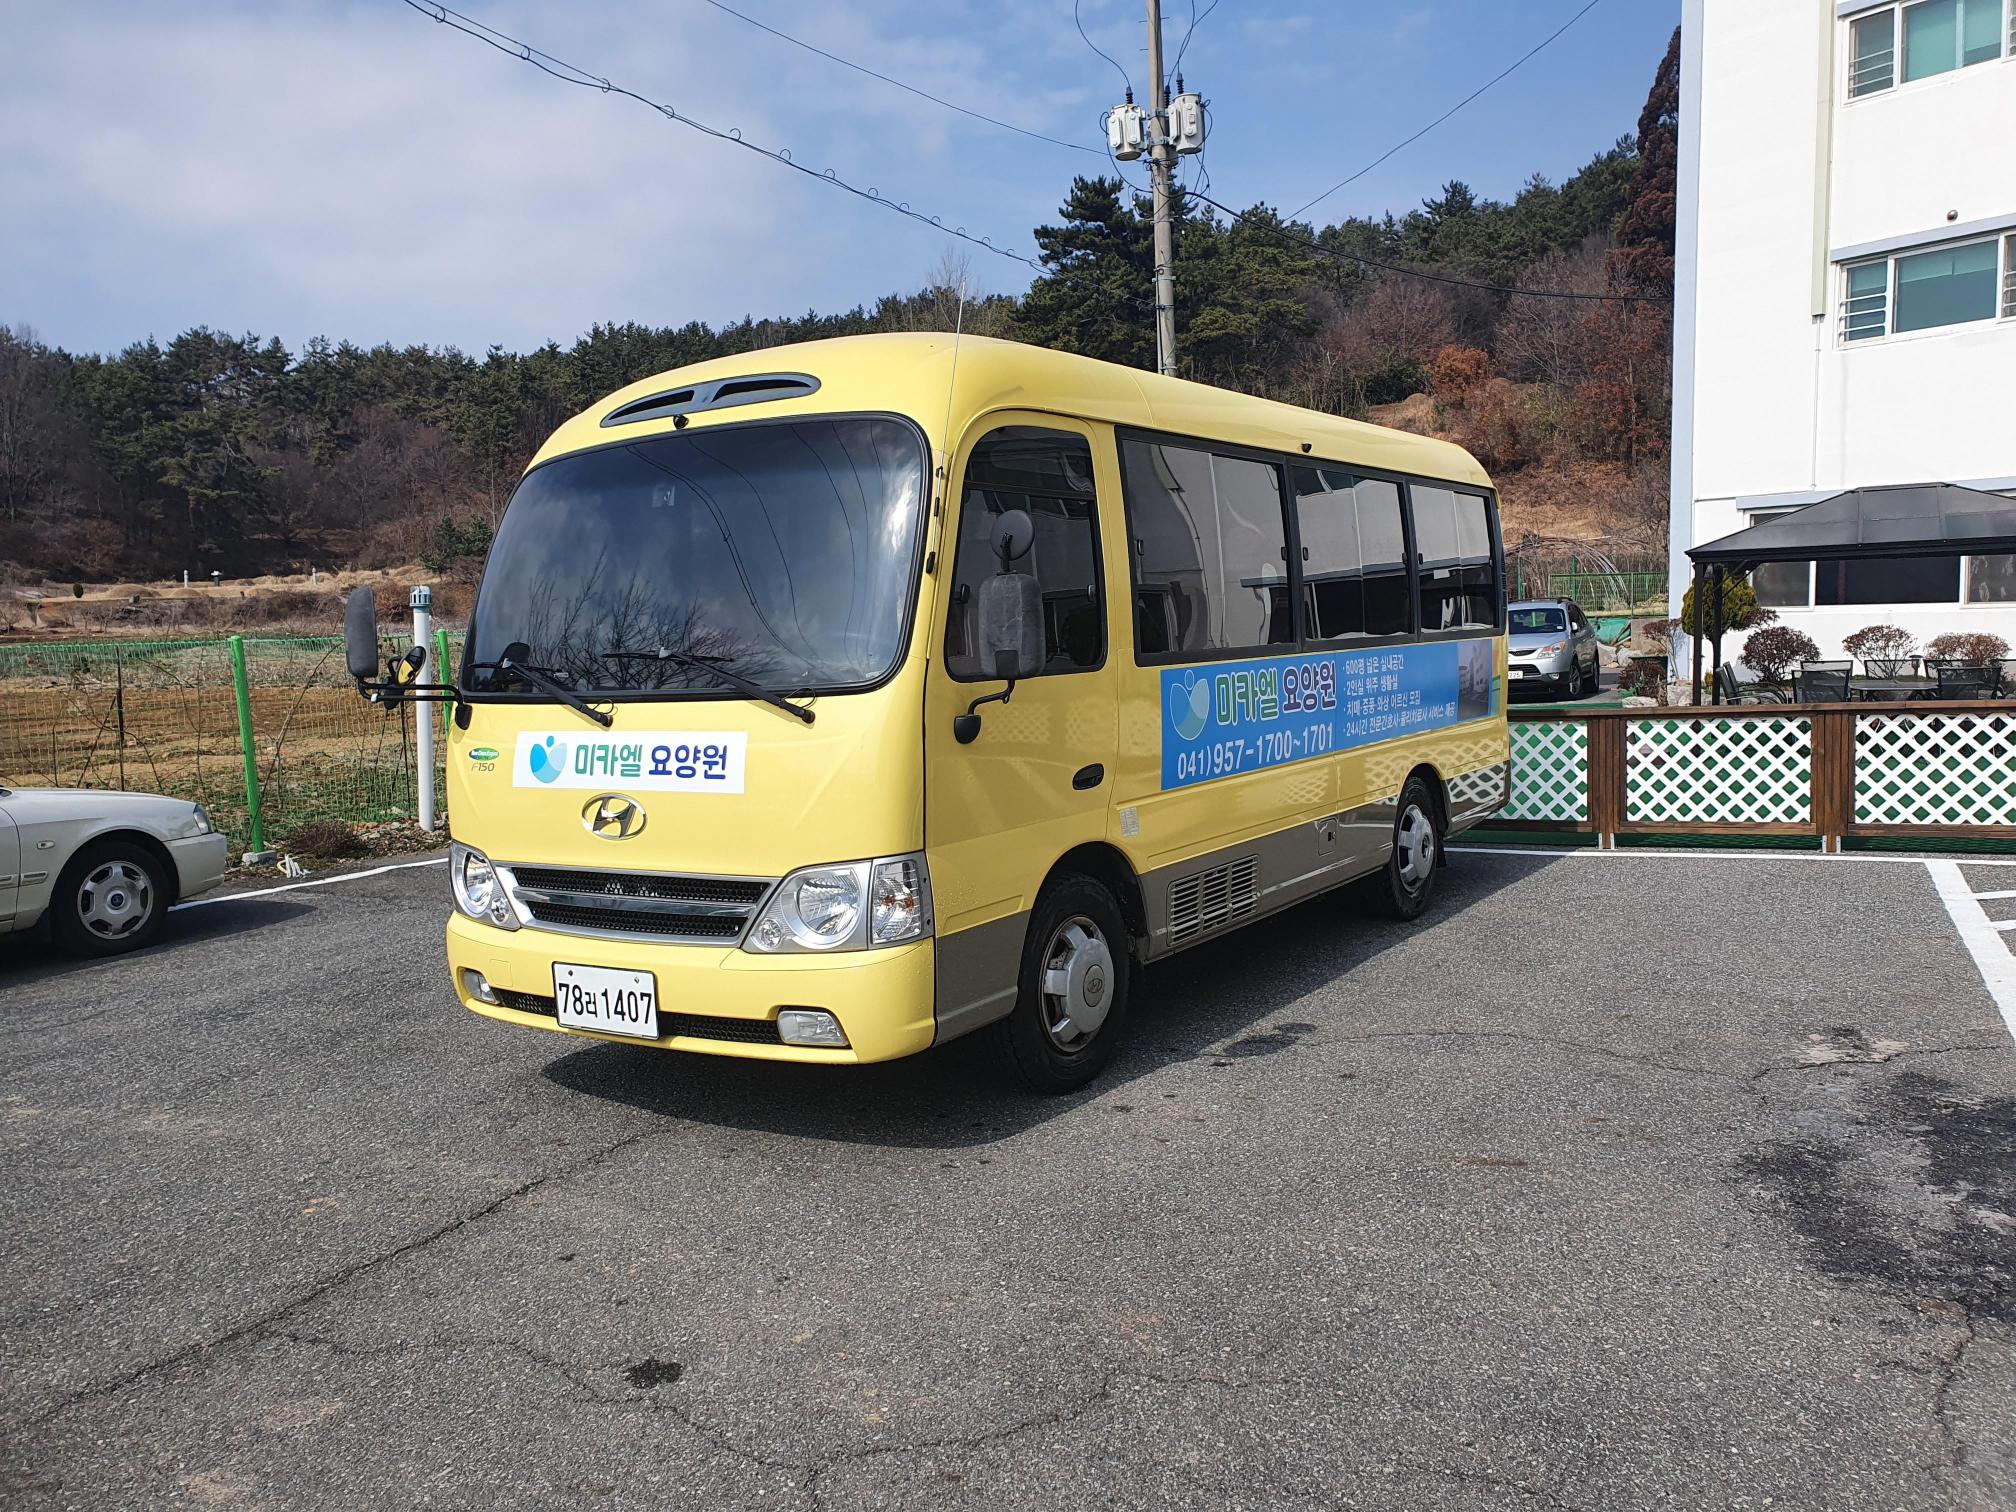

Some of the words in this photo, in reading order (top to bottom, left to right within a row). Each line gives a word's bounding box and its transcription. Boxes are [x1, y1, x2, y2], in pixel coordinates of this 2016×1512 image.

[1345, 658, 1365, 674] 600평
[1366, 656, 1380, 674] 넓은
[1380, 654, 1405, 672] 실내공간
[1215, 667, 1280, 726] 미카엘
[1282, 660, 1337, 714] 요양원
[1346, 678, 1364, 697] 2인실
[1365, 677, 1379, 694] 위주
[1380, 673, 1398, 692] 생활실
[1377, 694, 1389, 712] 와상
[1390, 690, 1409, 710] 어르신
[1409, 689, 1421, 706] 모집
[1346, 717, 1368, 737] 24시간
[1428, 703, 1444, 720] 서비스
[1445, 701, 1456, 717] 제공
[575, 743, 643, 777] 미카엘
[648, 744, 728, 780] 요양원
[1177, 721, 1333, 781] 041)957-1700~1701
[472, 762, 496, 772] F150
